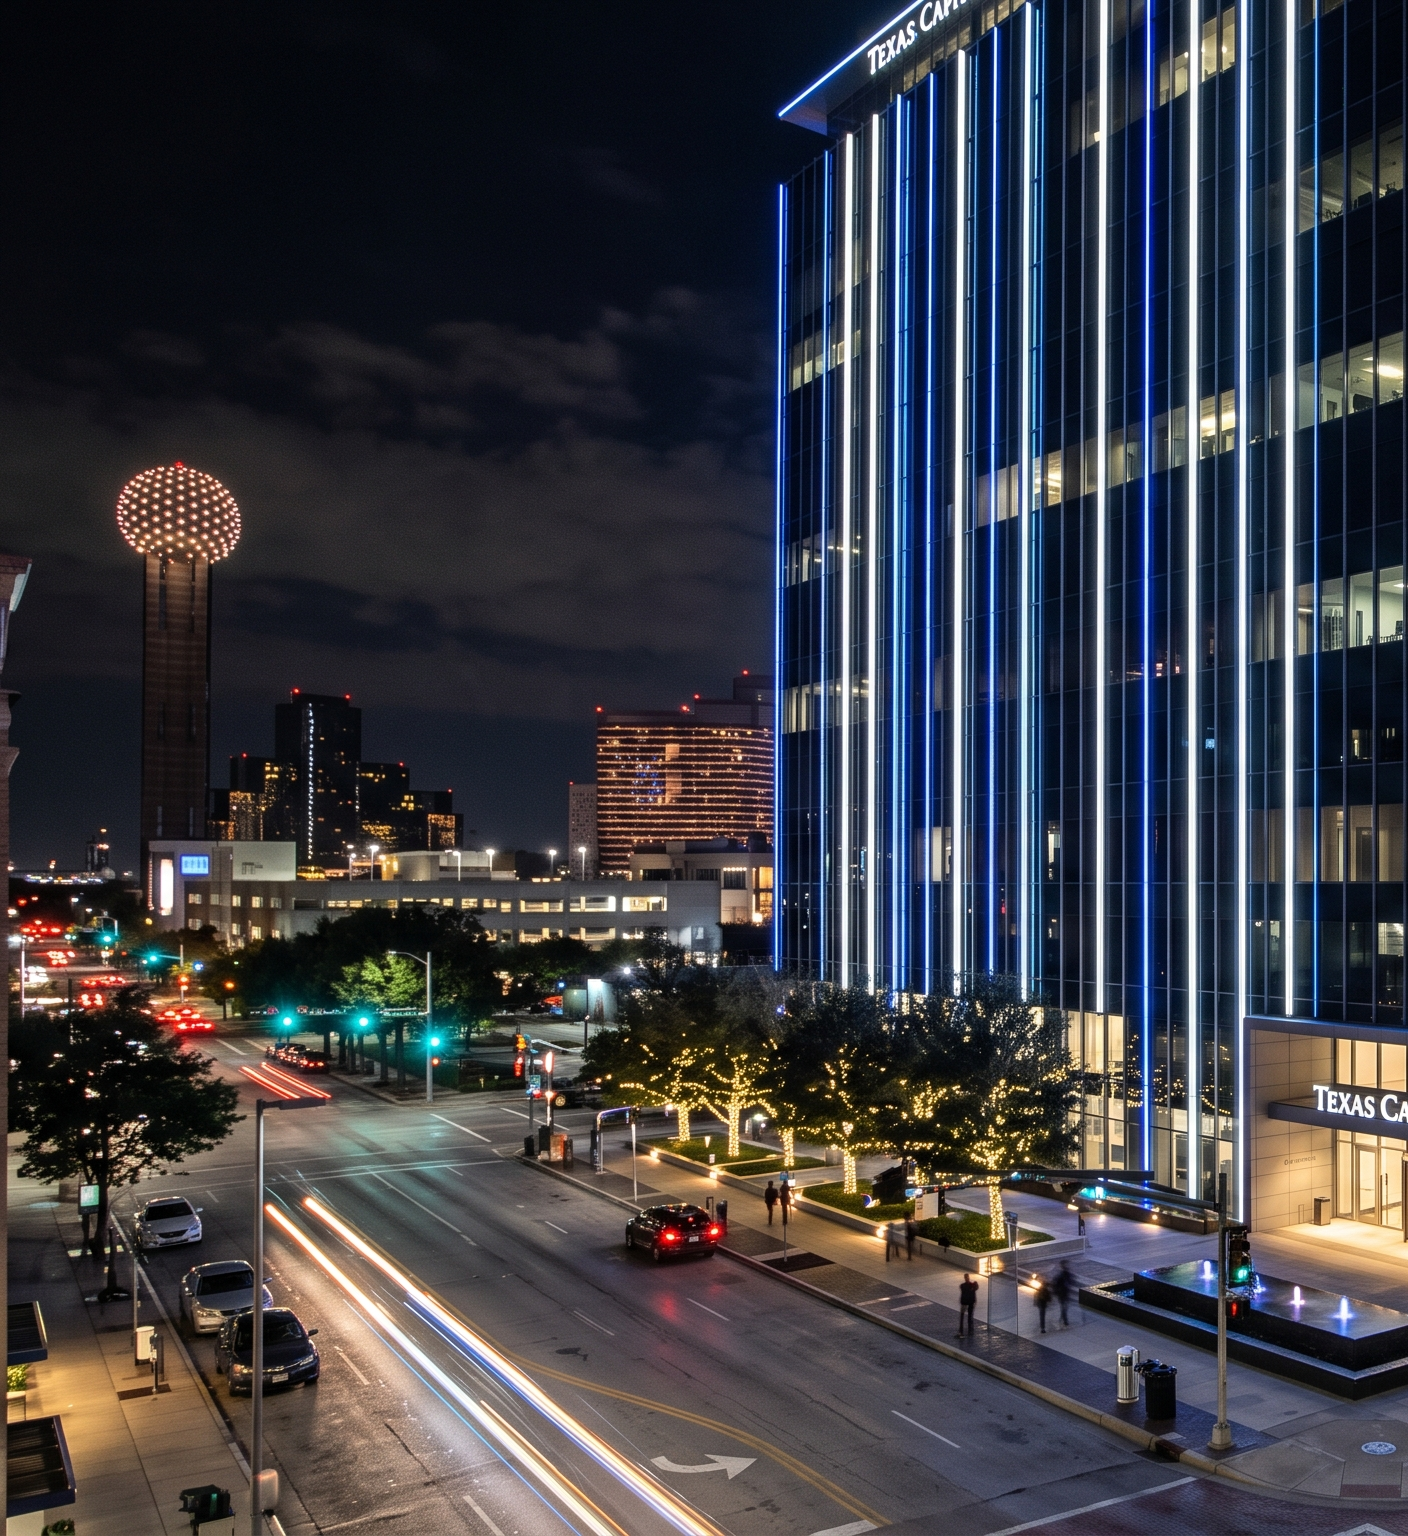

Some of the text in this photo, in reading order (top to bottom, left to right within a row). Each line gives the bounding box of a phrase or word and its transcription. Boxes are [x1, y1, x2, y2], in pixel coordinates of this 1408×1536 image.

[868, 0, 967, 75] TEXAS CAP
[1312, 1085, 1375, 1118] TEXAS
